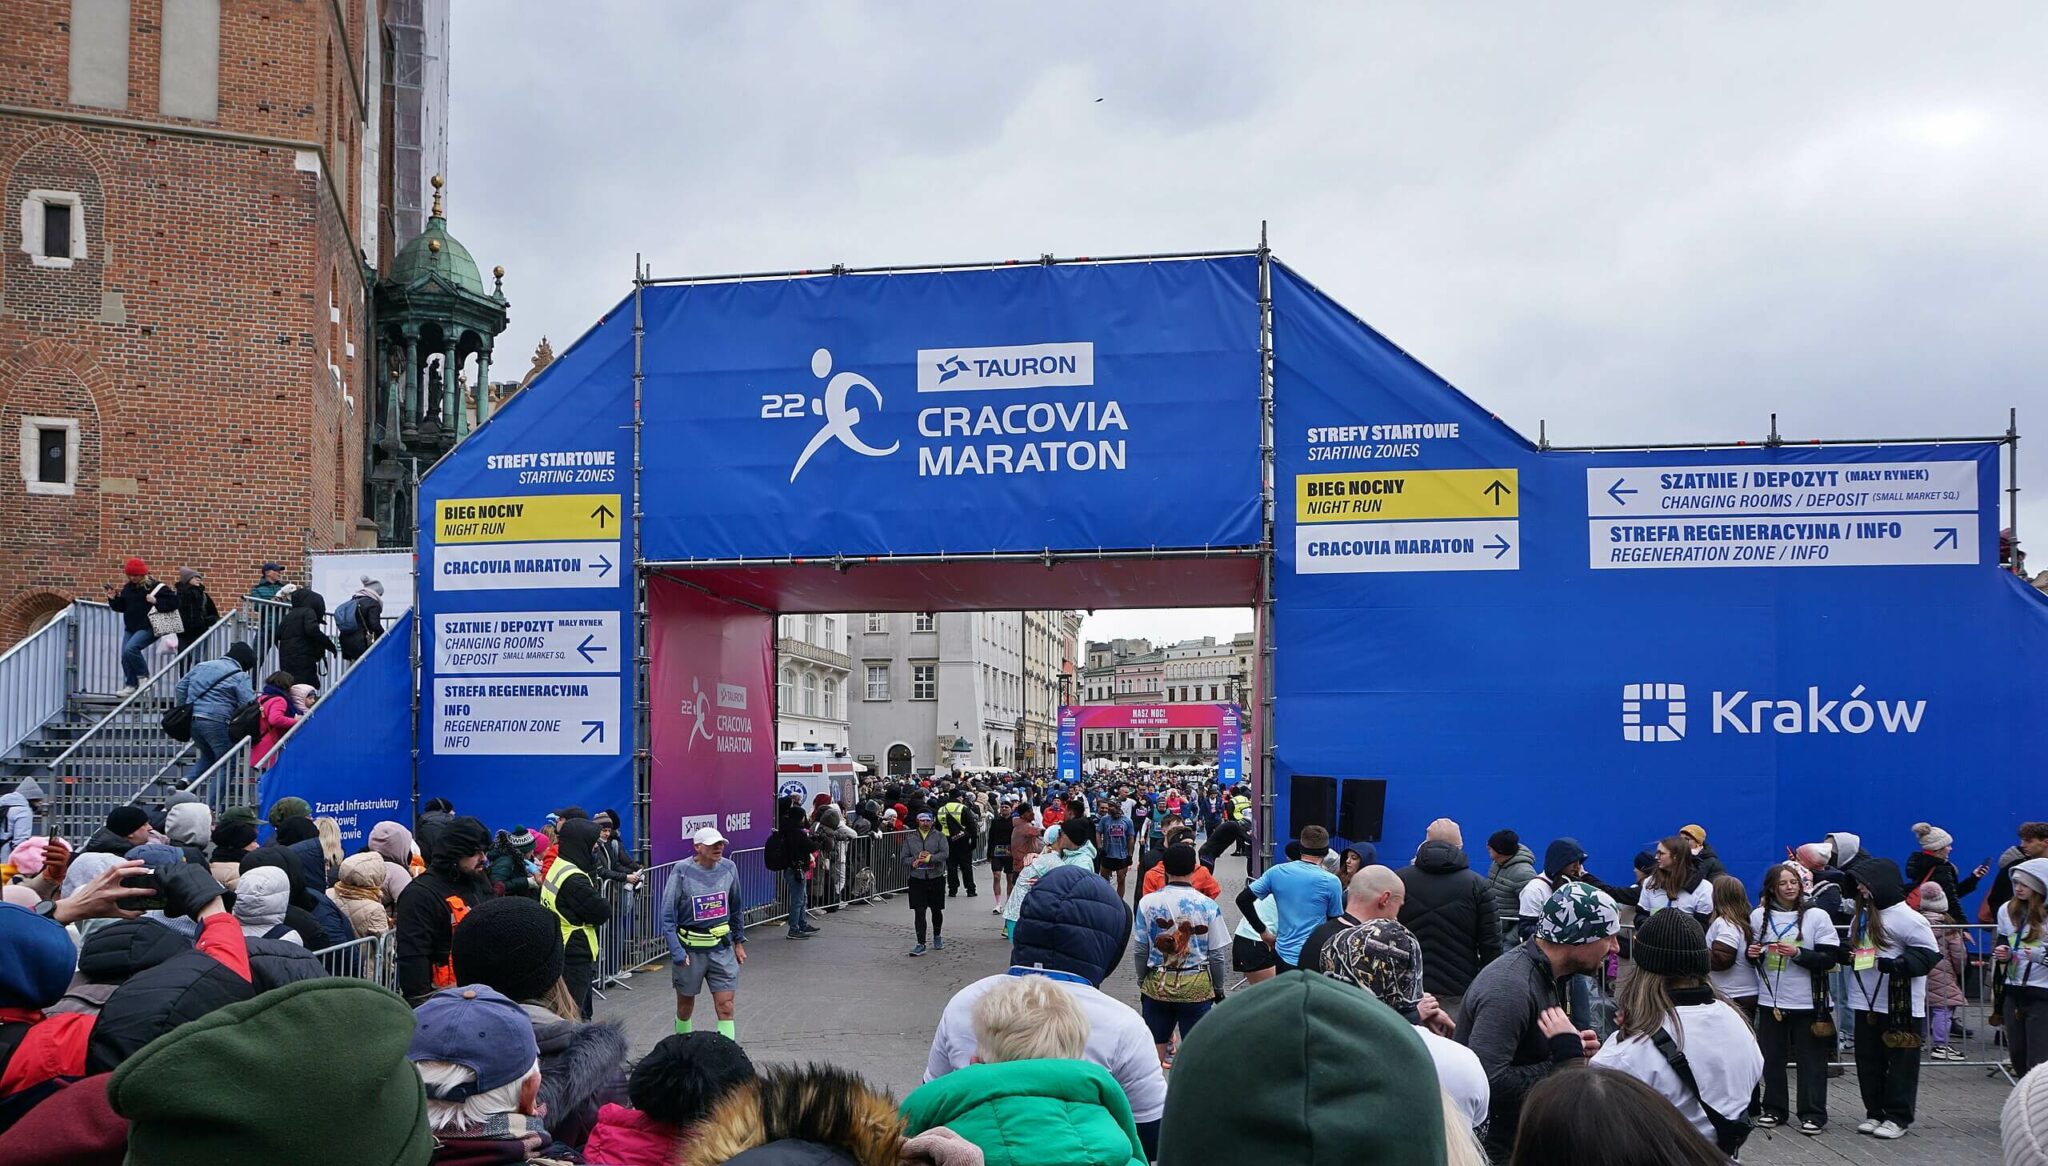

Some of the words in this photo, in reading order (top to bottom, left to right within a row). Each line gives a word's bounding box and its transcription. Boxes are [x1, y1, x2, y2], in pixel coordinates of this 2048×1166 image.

[973, 355, 1076, 379] TAURON
[761, 394, 805, 419] 22
[917, 400, 1129, 438] CRACOVIA
[1307, 426, 1369, 443] STREFY
[1371, 423, 1460, 441] STARTOWE
[487, 453, 538, 469] STREFY
[540, 451, 615, 467] STARTOWE
[918, 440, 1127, 477] MARATON
[1307, 445, 1372, 461] STARTING
[1374, 443, 1420, 459] ZONES
[519, 470, 573, 484] STARTING
[575, 469, 615, 483] ZONES
[1660, 472, 1739, 490] SZATNIE
[1742, 472, 1749, 489] /
[1753, 470, 1839, 488] DEPOZYT
[1845, 469, 1882, 484] (MAŁY
[1883, 468, 1929, 482] RYNEK)
[1307, 481, 1345, 497] BIEG
[1349, 479, 1405, 495] NOCNY
[1307, 500, 1350, 515] NIGHT
[1352, 499, 1383, 513] RUN
[1661, 495, 1737, 510] CHANGING
[1739, 494, 1793, 508] ROOMS
[1796, 494, 1803, 508] /
[1806, 492, 1869, 507] DEPOSIT
[1872, 491, 1903, 503] (SMALL
[1904, 491, 1941, 502] MARKET
[1942, 490, 1960, 501] SQ.)
[445, 505, 477, 520] BIEG
[478, 504, 524, 518] NOCNY
[444, 523, 479, 537] NIGHT
[480, 522, 505, 535] RUN
[1610, 524, 1680, 543] STREFA
[1682, 522, 1842, 542] REGENERACYJNA
[1845, 523, 1852, 540] /
[1857, 521, 1902, 539] INFO
[1307, 541, 1390, 557] CRACOVIA
[1394, 538, 1474, 555] MARATON
[1610, 546, 1731, 563] REGENERATION
[1733, 545, 1777, 561] ZONE
[1779, 545, 1788, 561] /
[1790, 545, 1829, 561] INFO
[443, 559, 512, 575] CRACOVIA
[514, 558, 581, 573] MARATON
[445, 620, 492, 634] SZATNIE
[494, 620, 499, 633] /
[501, 619, 554, 633] DEPOZYT
[558, 619, 578, 627] MAŁY
[579, 618, 603, 627] RYNEK
[445, 637, 501, 650] CHANGING
[503, 636, 544, 649] ROOMS
[452, 653, 499, 666] DEPOSIT
[502, 651, 524, 660] SMALL
[525, 651, 554, 660] MARKET
[445, 685, 486, 698] STREFA
[488, 684, 588, 698] REGENERACYJNA
[444, 704, 470, 716] INFO
[681, 700, 693, 715] 22
[1712, 684, 1928, 734] Kraków
[444, 720, 528, 733] REGENERATION
[529, 719, 561, 732] ZONE
[717, 715, 752, 734] CRACOVIA
[444, 736, 470, 748] INFO
[717, 735, 752, 753] MARATON
[315, 801, 344, 814] Zarząd
[346, 798, 399, 810] Infrastruktury
[725, 812, 751, 832] OSHEE
